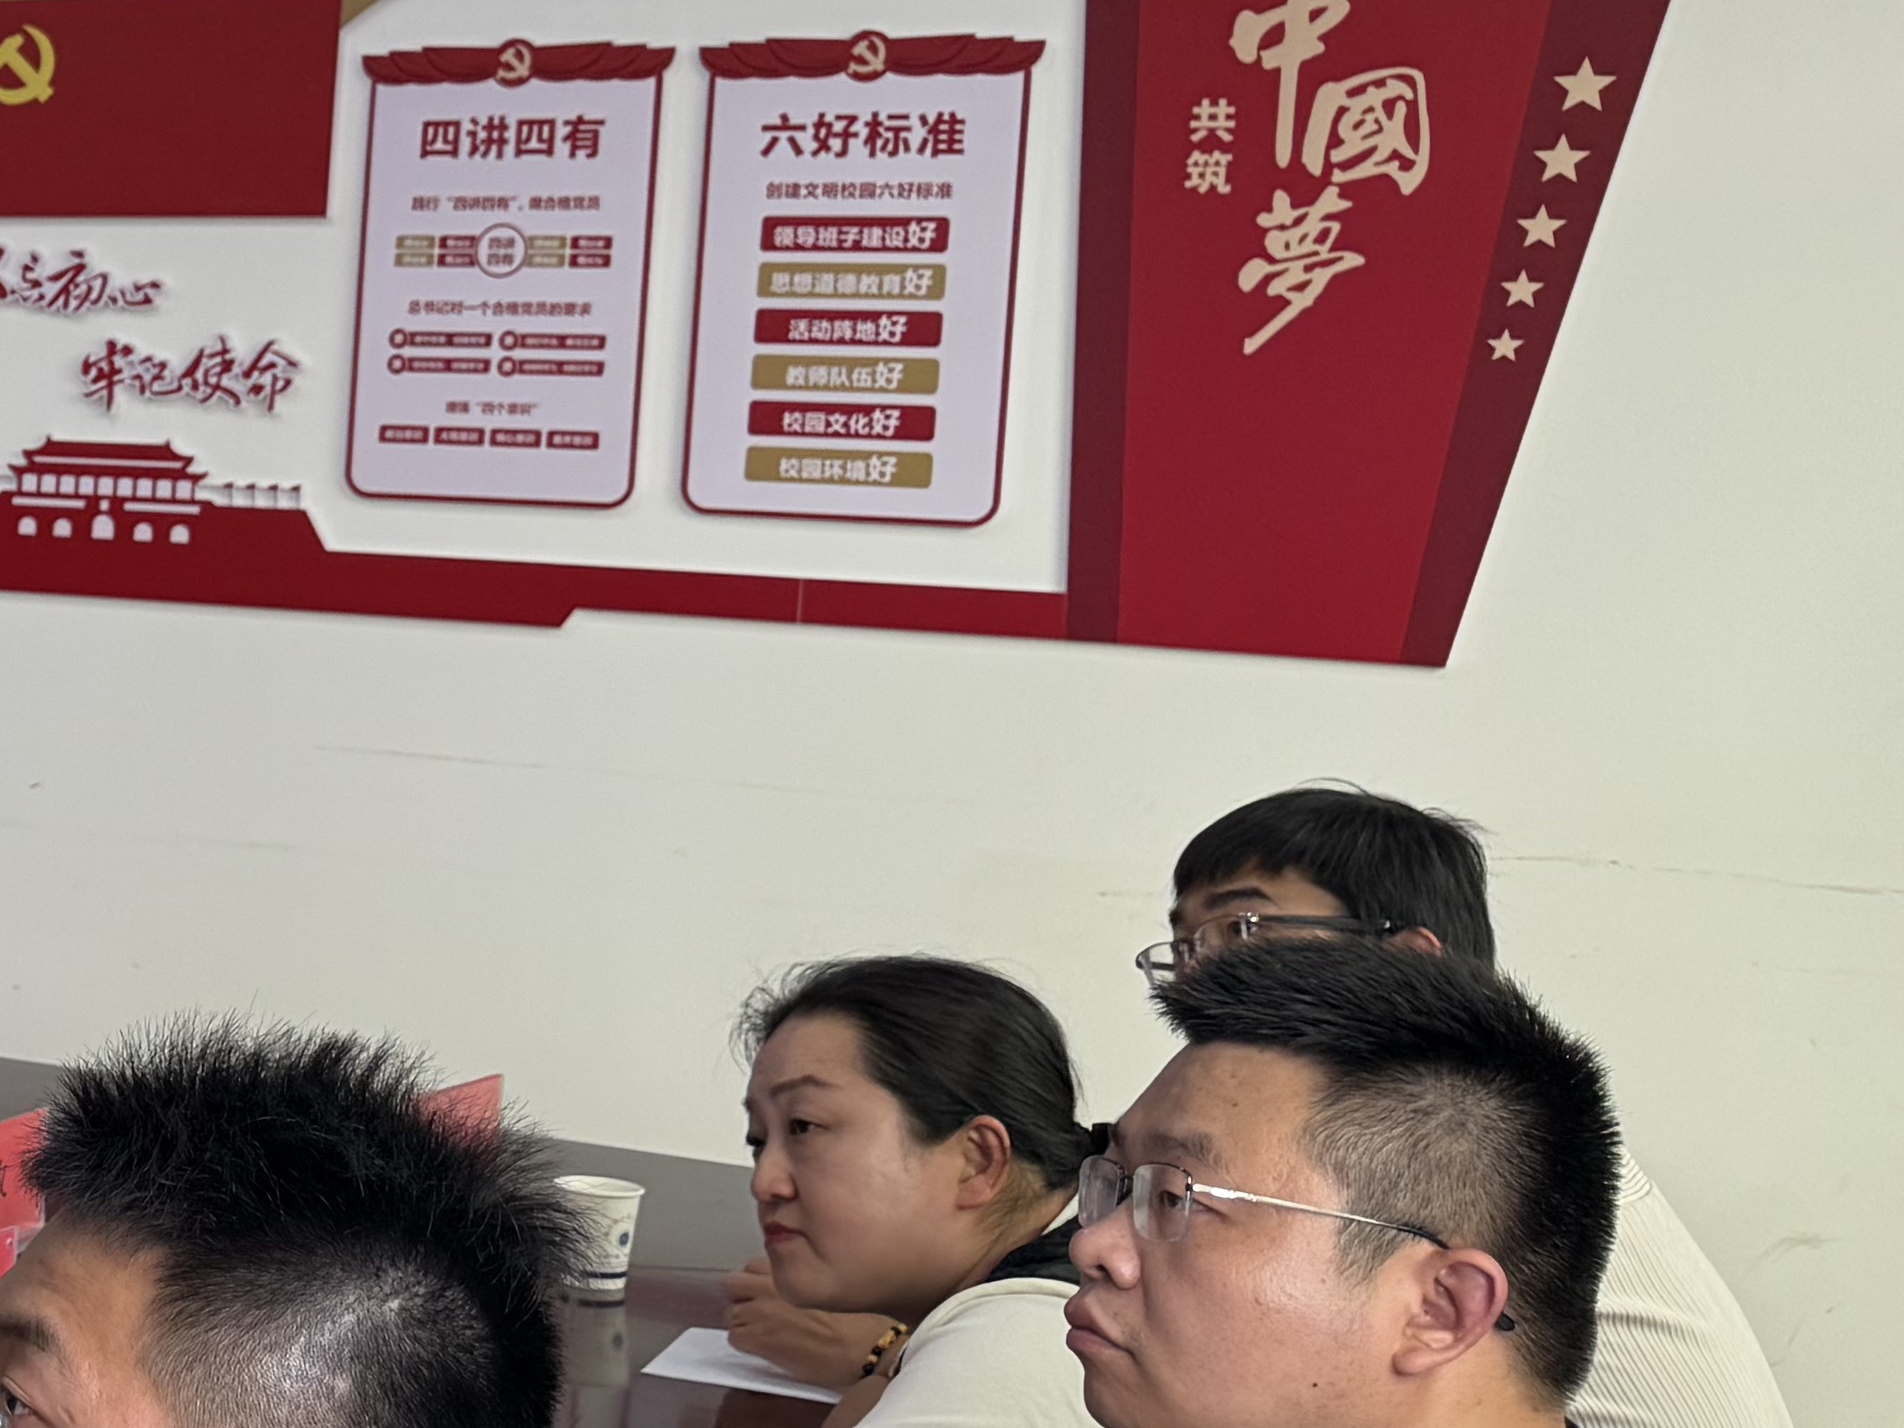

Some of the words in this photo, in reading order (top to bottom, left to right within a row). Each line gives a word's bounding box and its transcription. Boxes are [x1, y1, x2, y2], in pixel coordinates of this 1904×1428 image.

[420, 115, 605, 159] 四讲四有
[761, 112, 965, 158] 六好标准
[1185, 99, 1235, 193] 共筑
[767, 183, 952, 199] 创建文明校园六好标准
[775, 222, 936, 248] 领导班子建设好
[770, 267, 933, 296] 思想道德教育好
[789, 315, 906, 342] 活动阵地好
[82, 337, 297, 412] 牢记使命
[786, 361, 904, 389] 教师队伍好
[782, 408, 901, 437] 校园文化好
[779, 454, 897, 483] 校园环境好
